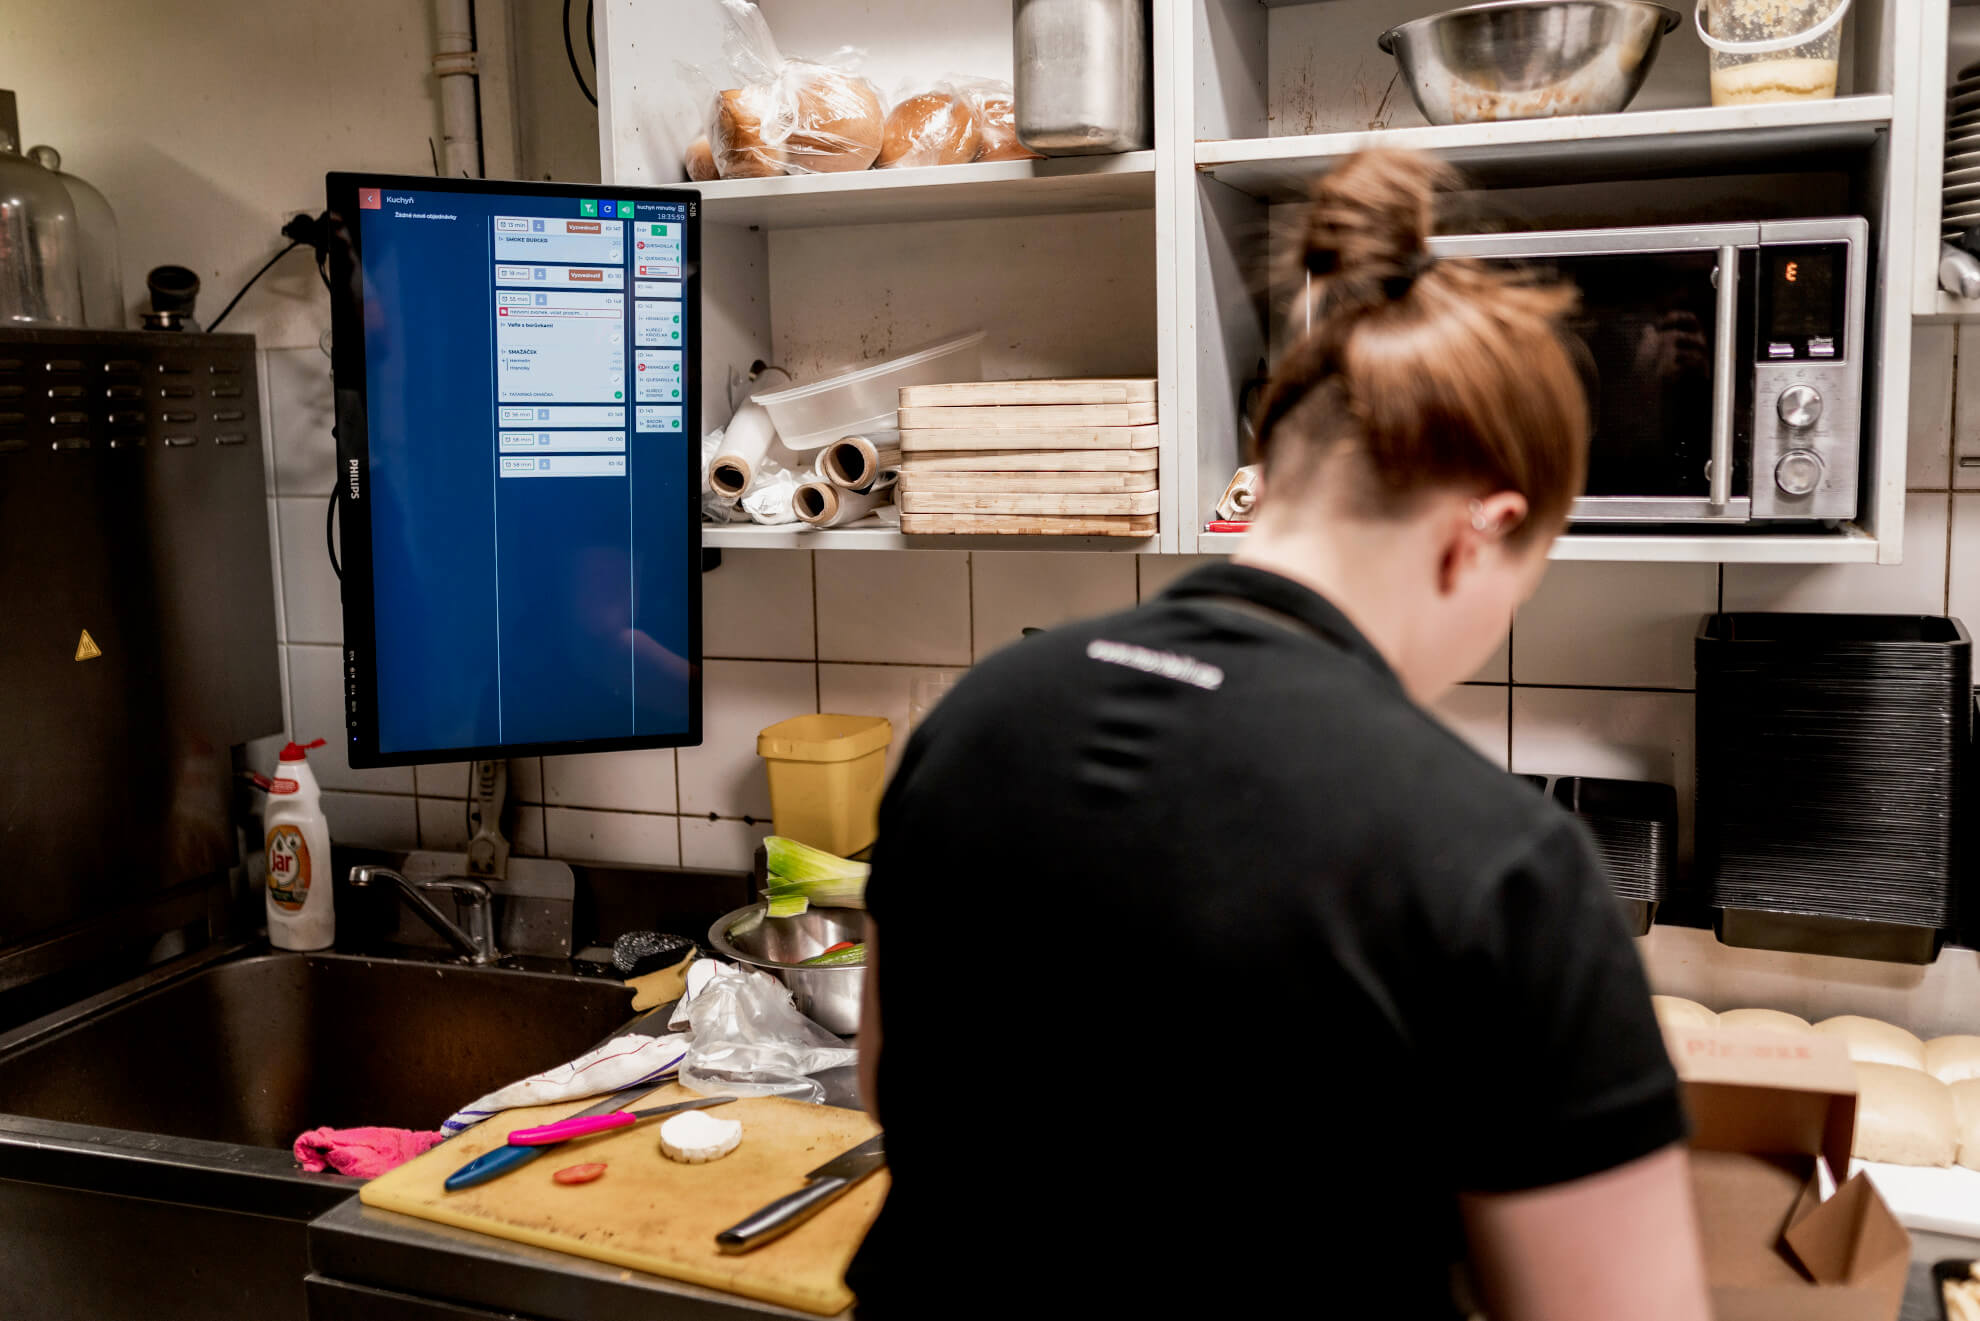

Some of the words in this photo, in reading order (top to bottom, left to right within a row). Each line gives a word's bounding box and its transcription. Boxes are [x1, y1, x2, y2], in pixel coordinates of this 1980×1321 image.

[1785, 261, 1798, 282] E
[349, 459, 360, 500] PHILIPS
[271, 850, 293, 873] Jar
